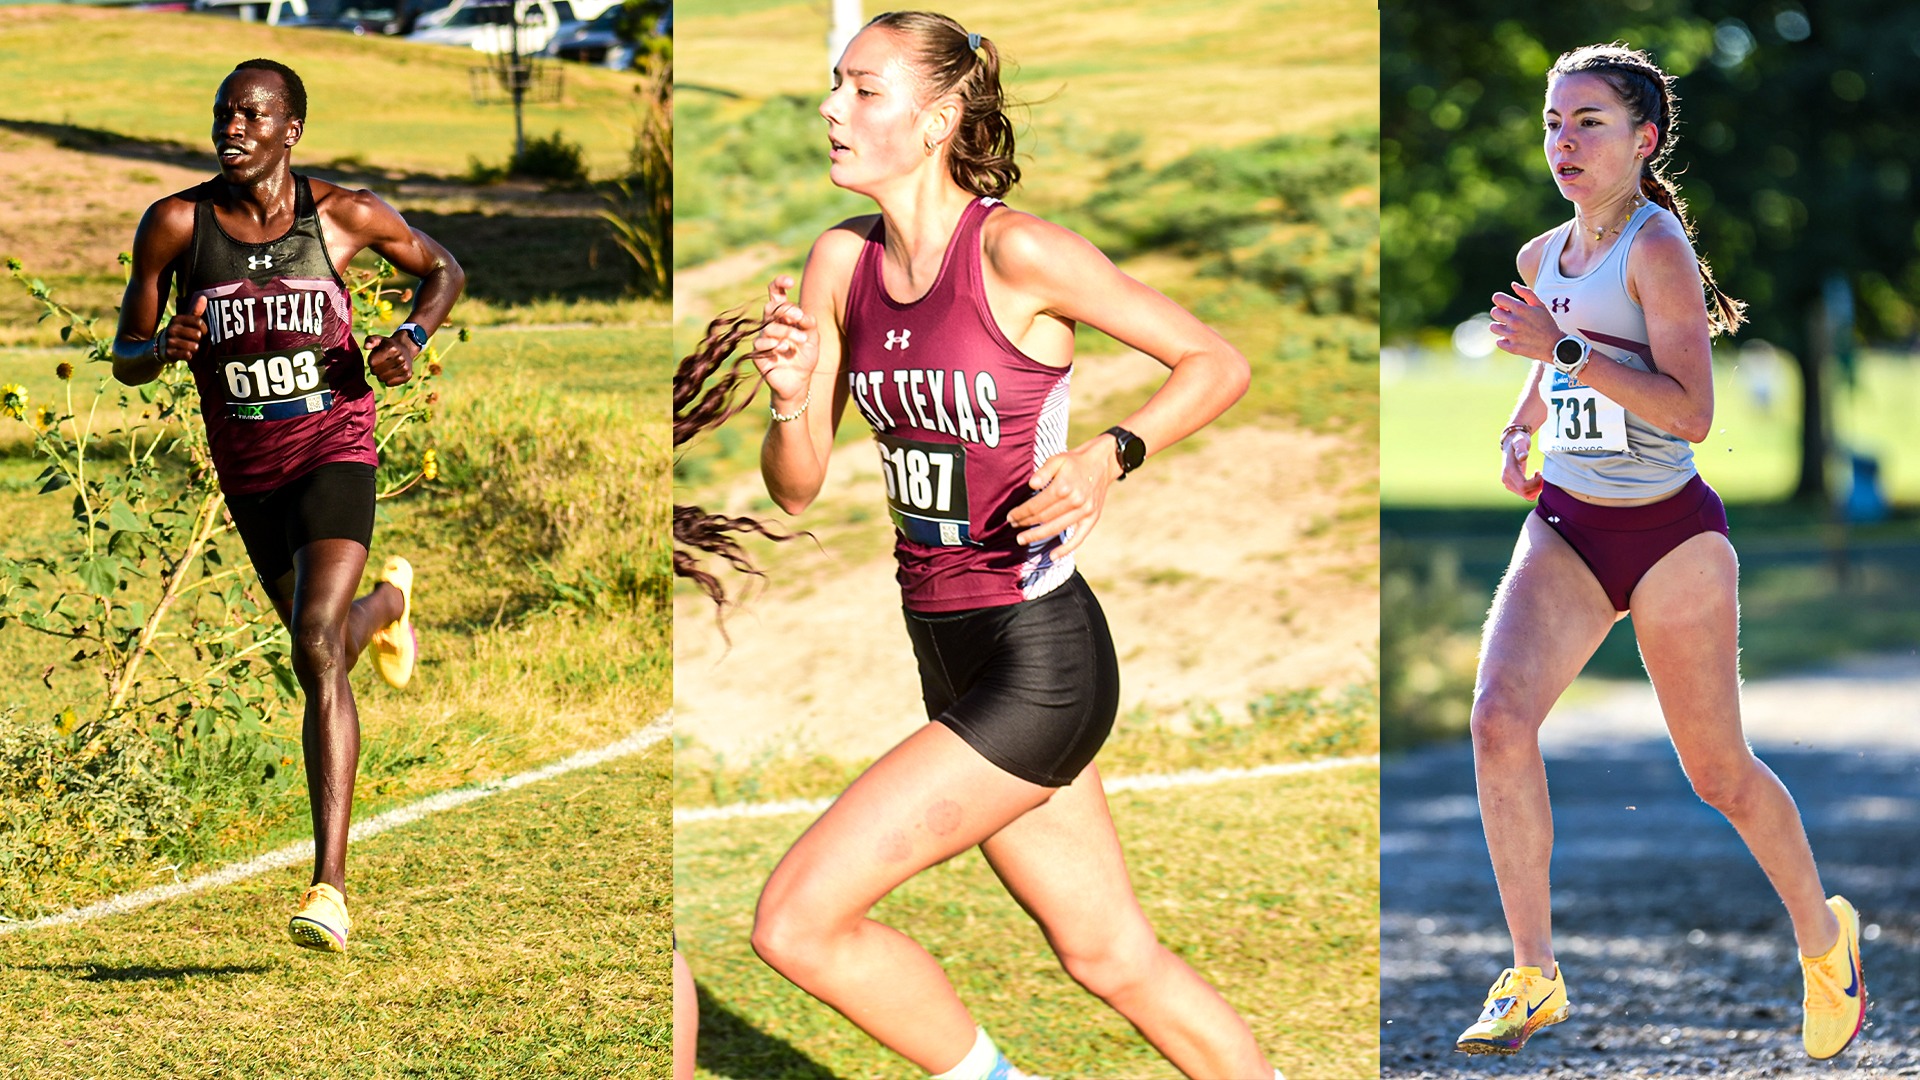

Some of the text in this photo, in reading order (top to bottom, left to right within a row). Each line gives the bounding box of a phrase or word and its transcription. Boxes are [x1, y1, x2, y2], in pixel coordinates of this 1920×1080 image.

[206, 291, 325, 345] WEST TEXAS
[225, 350, 320, 398] 6193
[237, 405, 264, 416] NTX
[893, 369, 1000, 448] TEXAS
[1551, 397, 1603, 440] 731
